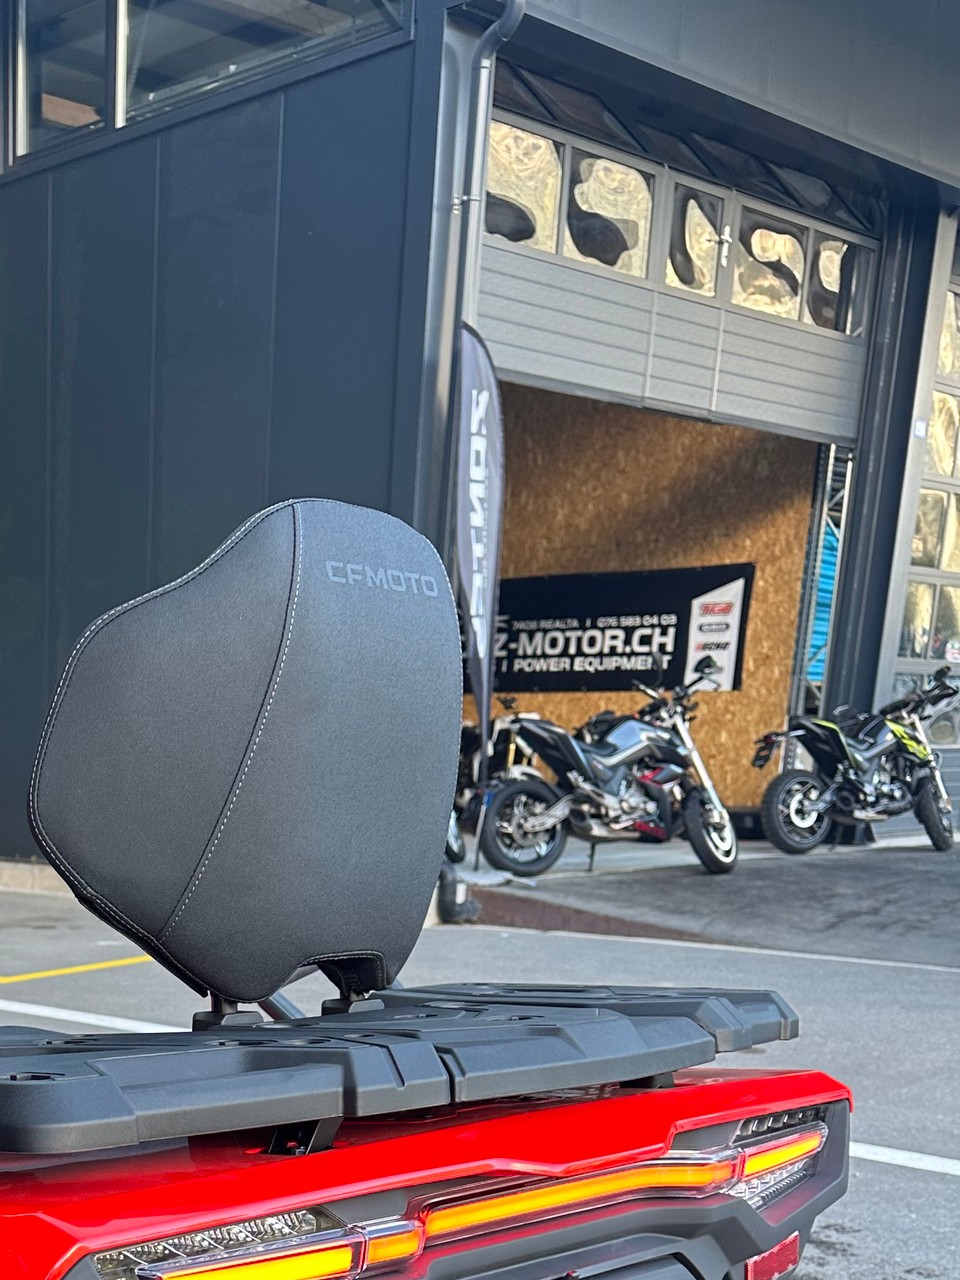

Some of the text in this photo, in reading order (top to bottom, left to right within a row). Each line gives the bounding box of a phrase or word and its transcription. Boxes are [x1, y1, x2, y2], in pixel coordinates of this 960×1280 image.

[325, 560, 438, 597] CFMOTO
[642, 614, 659, 626] 04
[660, 613, 678, 625] 03
[493, 626, 676, 658] Z-MOTOR.CH
[513, 657, 571, 672] POWER
